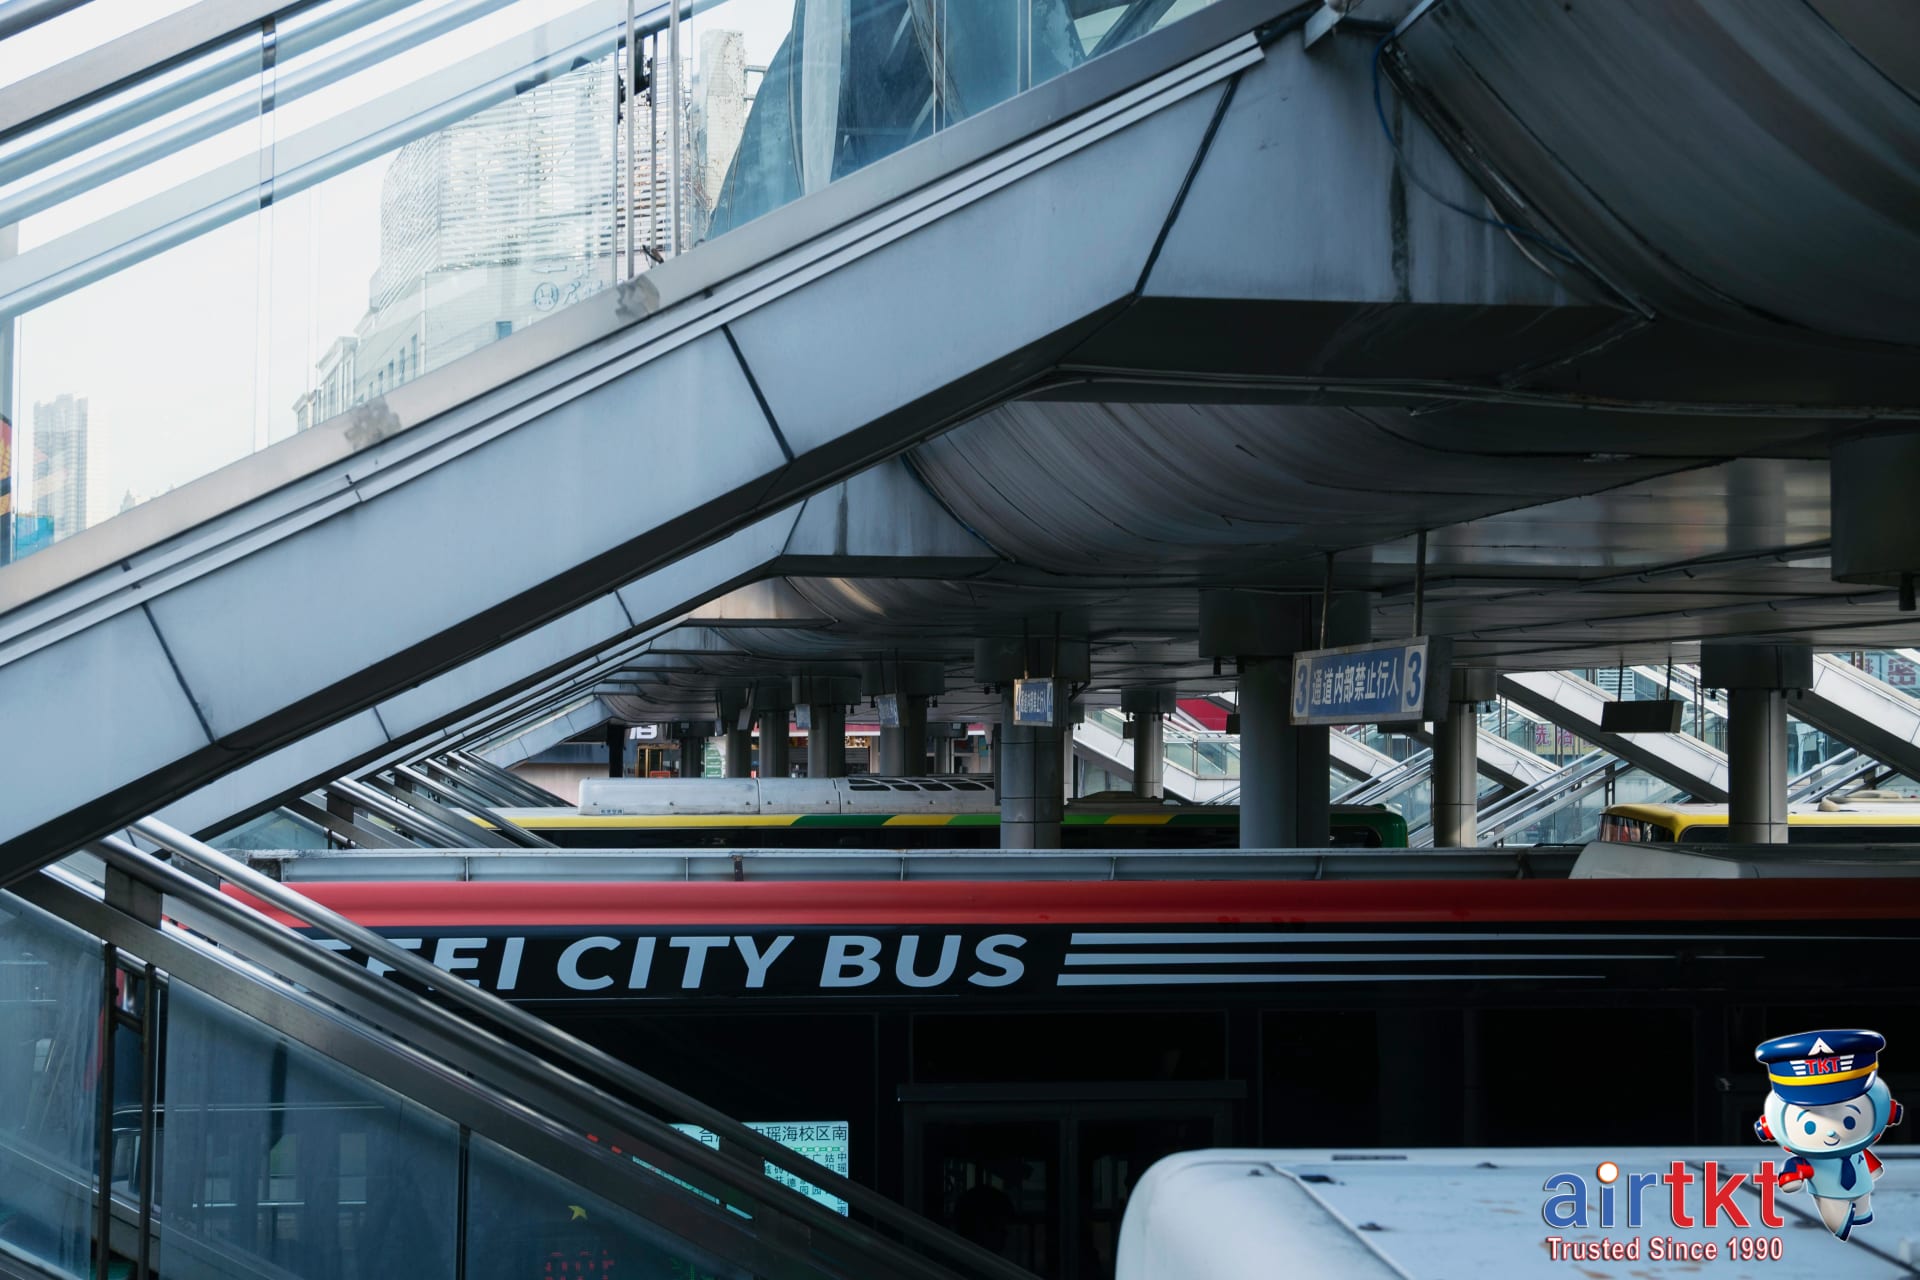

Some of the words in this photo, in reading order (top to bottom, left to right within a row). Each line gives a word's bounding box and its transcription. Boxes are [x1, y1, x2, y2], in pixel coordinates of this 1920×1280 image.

[1296, 664, 1309, 713] 3
[1311, 657, 1399, 705] 通道内部禁止行人
[1406, 651, 1422, 707] 3
[557, 936, 794, 989] CITY
[819, 934, 1026, 988] BUS
